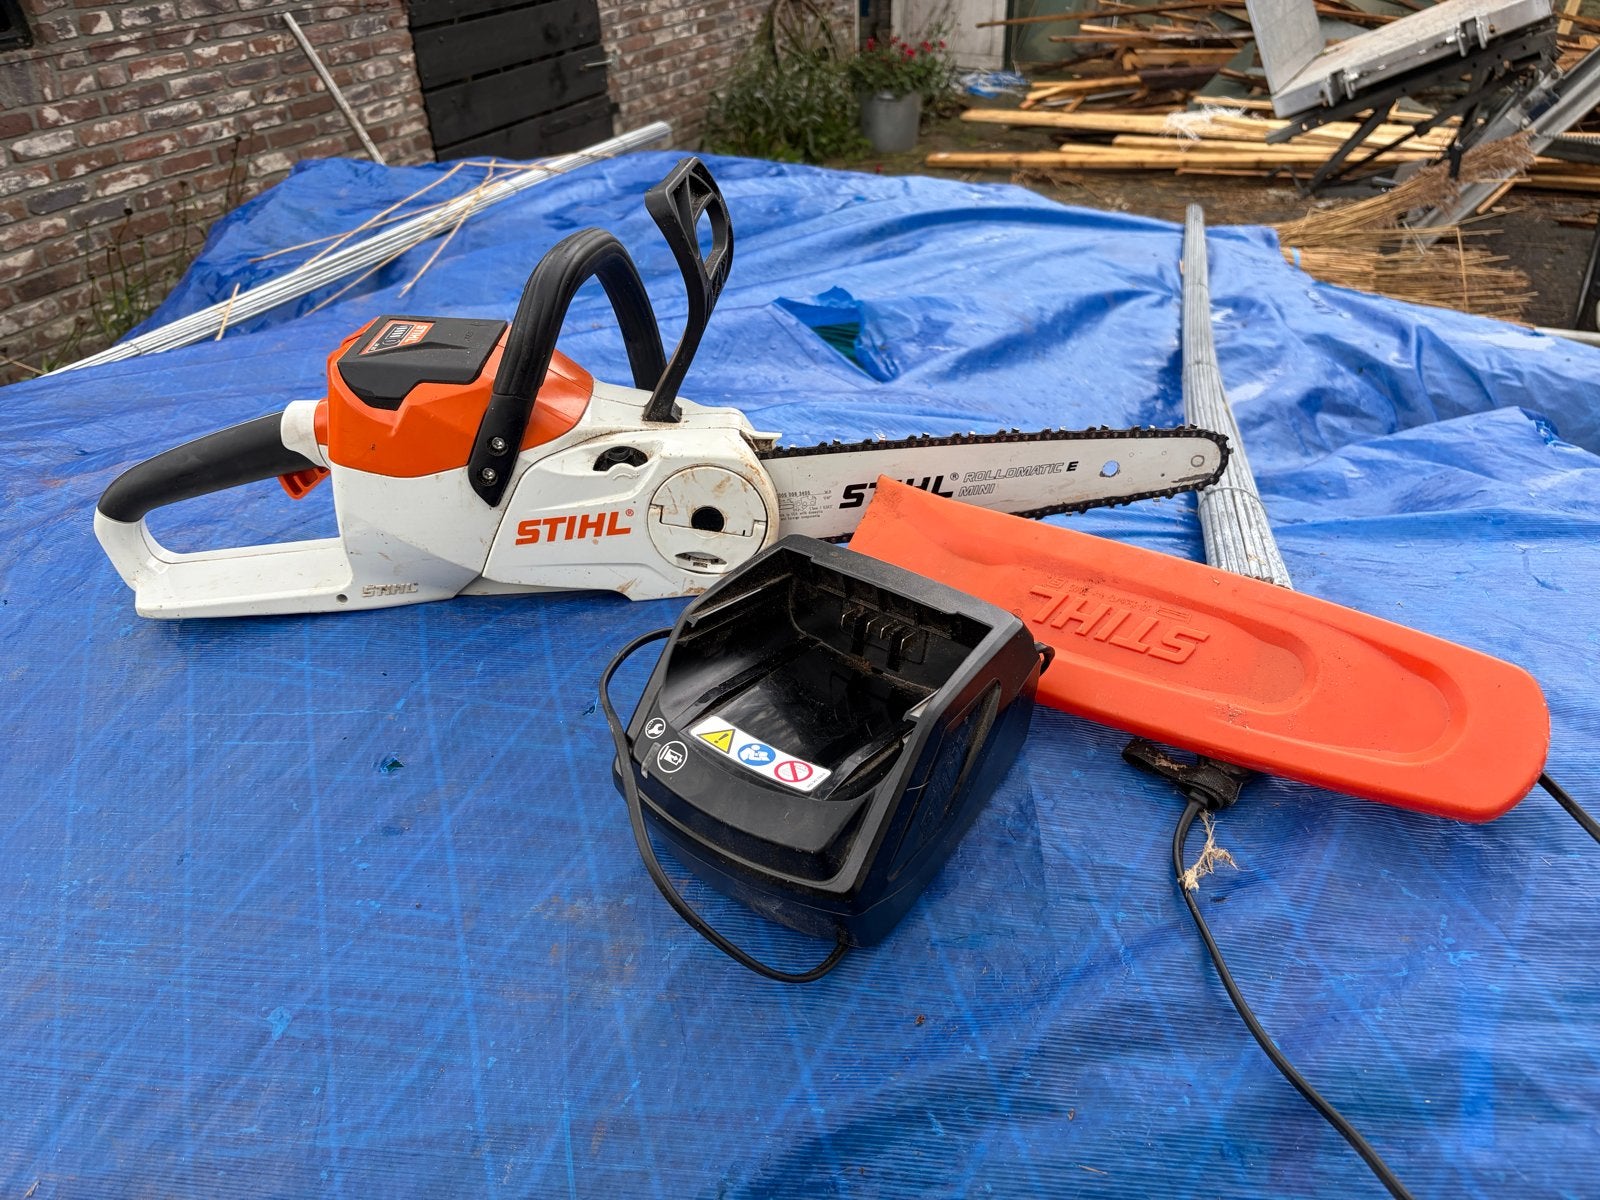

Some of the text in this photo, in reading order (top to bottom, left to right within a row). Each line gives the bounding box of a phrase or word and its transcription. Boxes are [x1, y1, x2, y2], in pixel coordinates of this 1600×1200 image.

[963, 461, 1079, 483] ROLLOMATIC E
[958, 483, 996, 497] MINI
[362, 582, 419, 598] STIHL
[1029, 585, 1211, 665] STIHL
